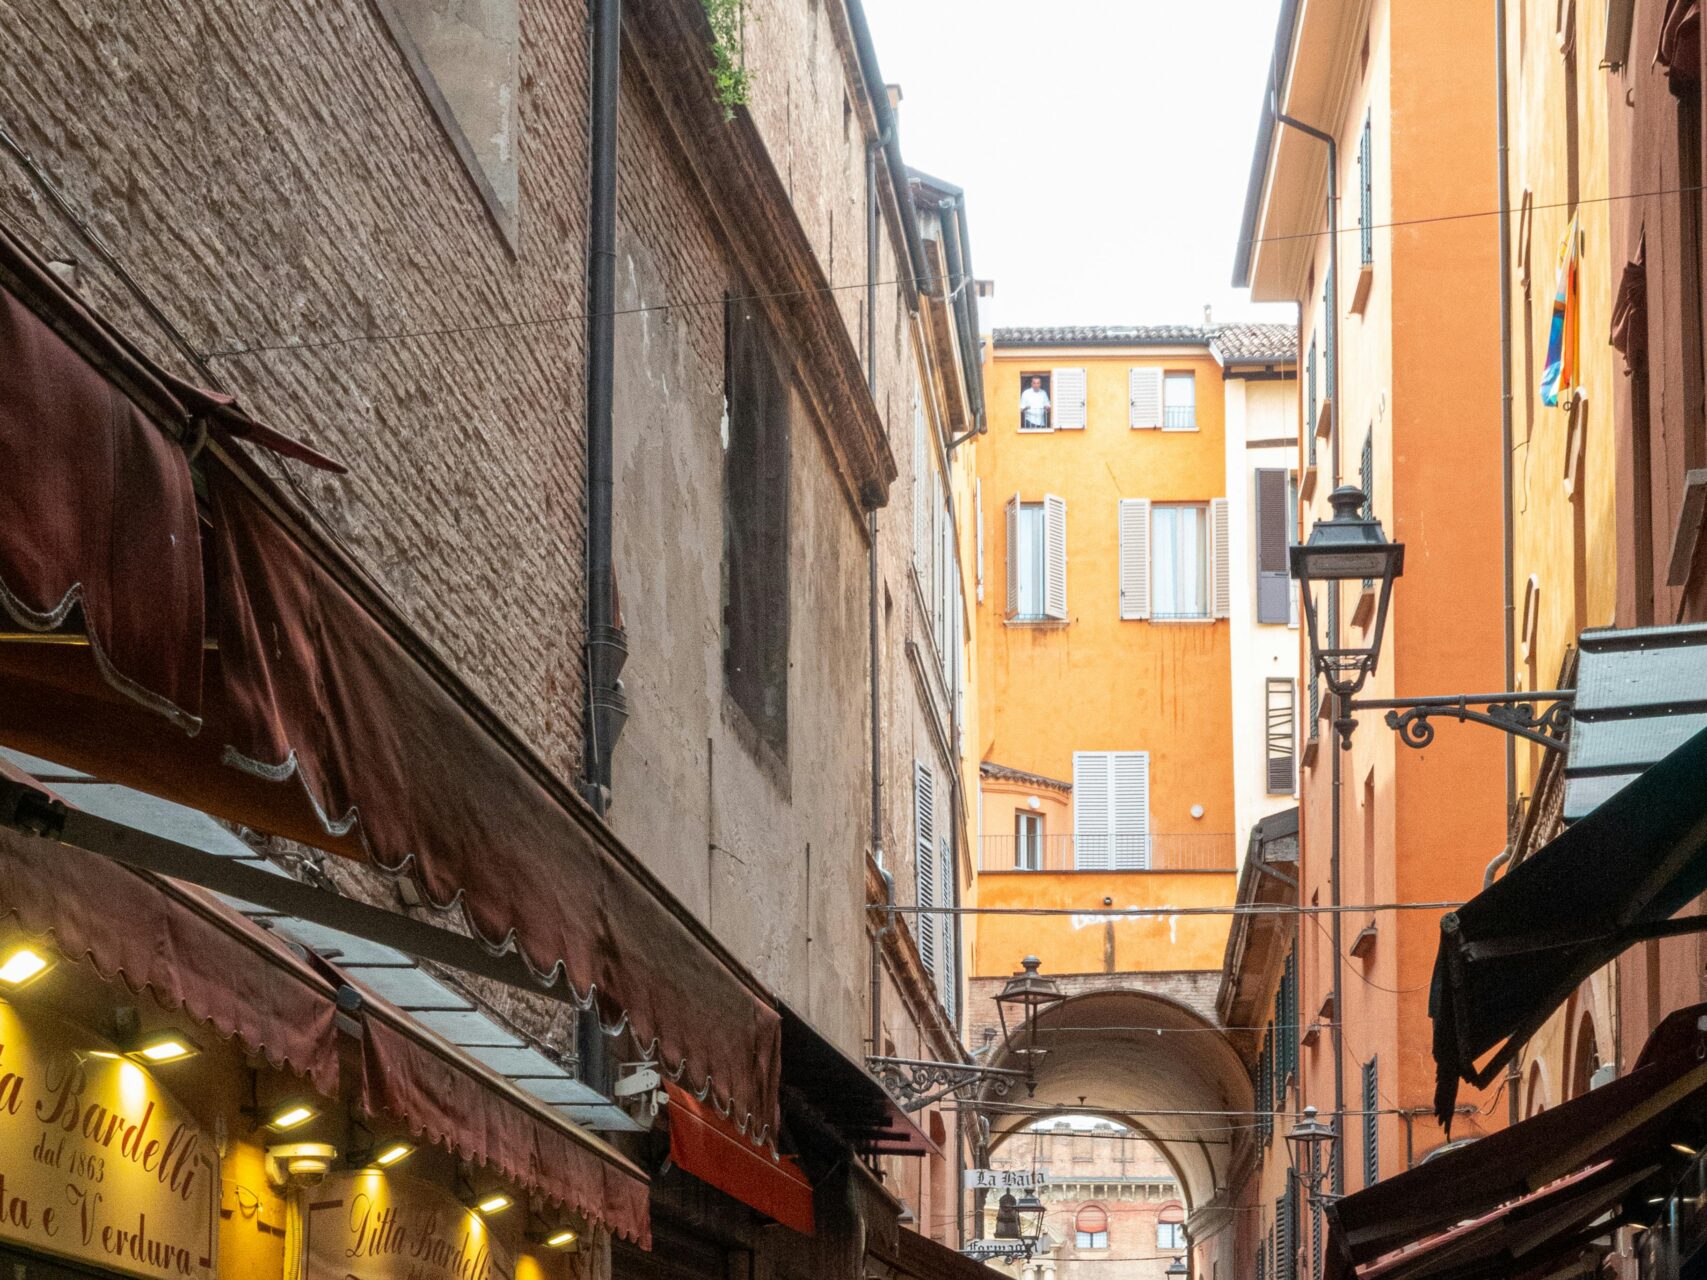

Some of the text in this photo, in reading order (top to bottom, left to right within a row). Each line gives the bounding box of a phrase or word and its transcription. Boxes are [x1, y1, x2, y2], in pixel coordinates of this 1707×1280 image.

[33, 1131, 105, 1184] dal 1863
[35, 1053, 199, 1202] Bardelli
[977, 1171, 996, 1187] La
[42, 1206, 59, 1237] e
[65, 1183, 193, 1277] Verdura
[345, 1193, 407, 1258] Ditta
